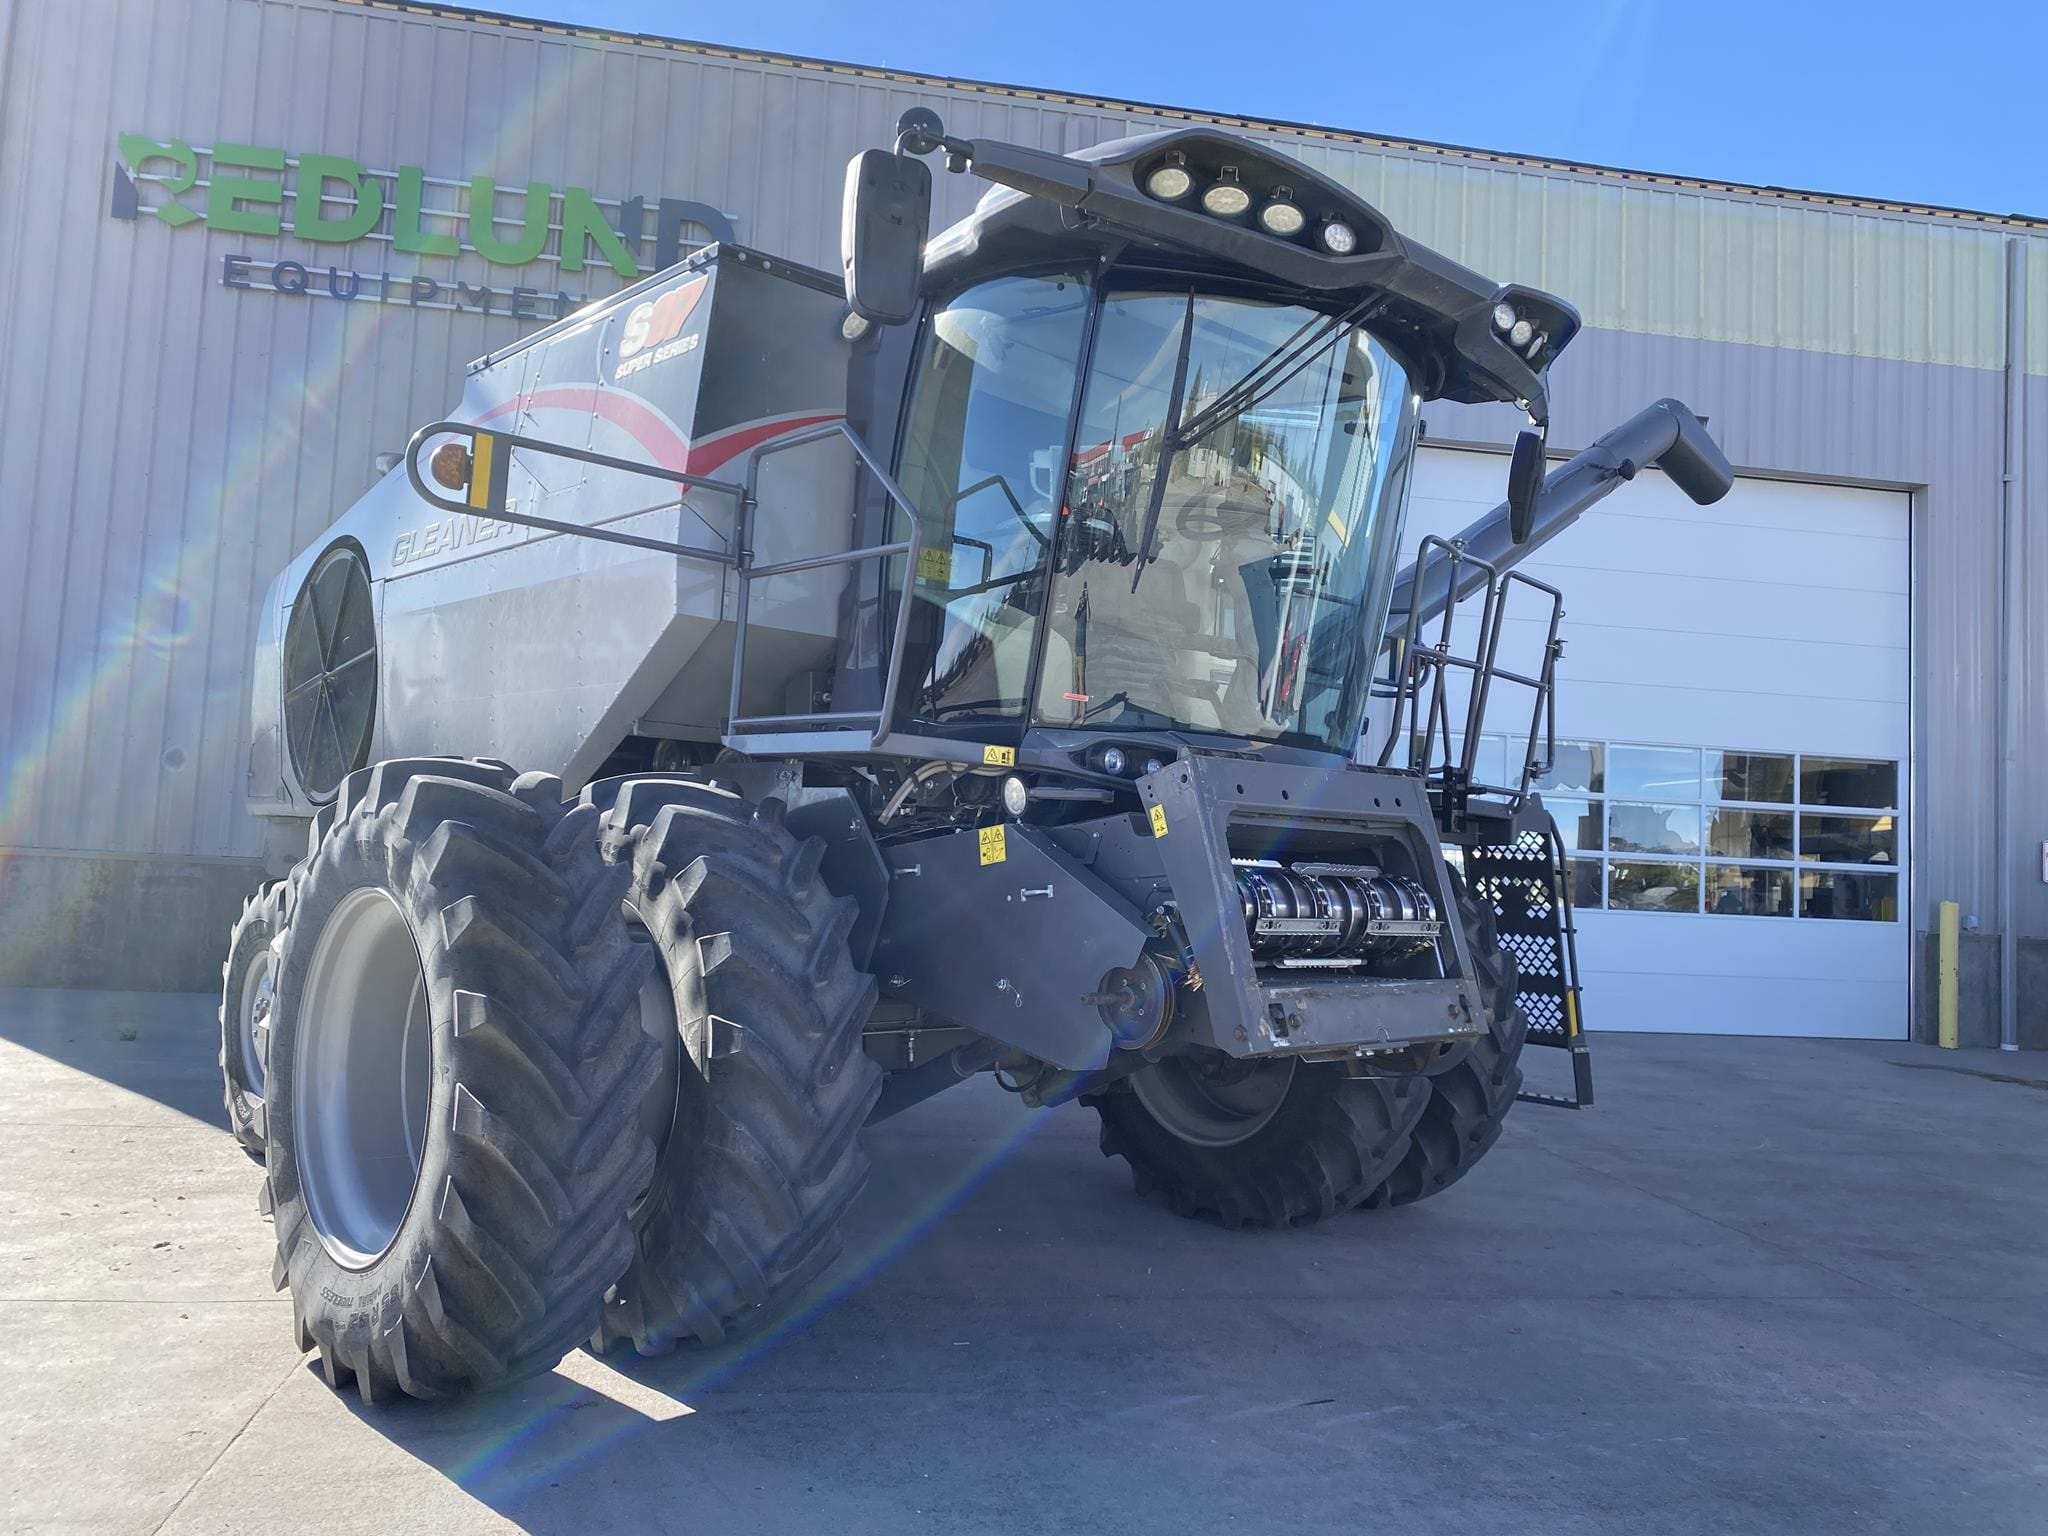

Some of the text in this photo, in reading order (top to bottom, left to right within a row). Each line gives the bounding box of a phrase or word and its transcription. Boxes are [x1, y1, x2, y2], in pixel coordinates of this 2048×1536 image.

[111, 130, 736, 277] REDLUND
[615, 333, 699, 380] SUPER SERIES
